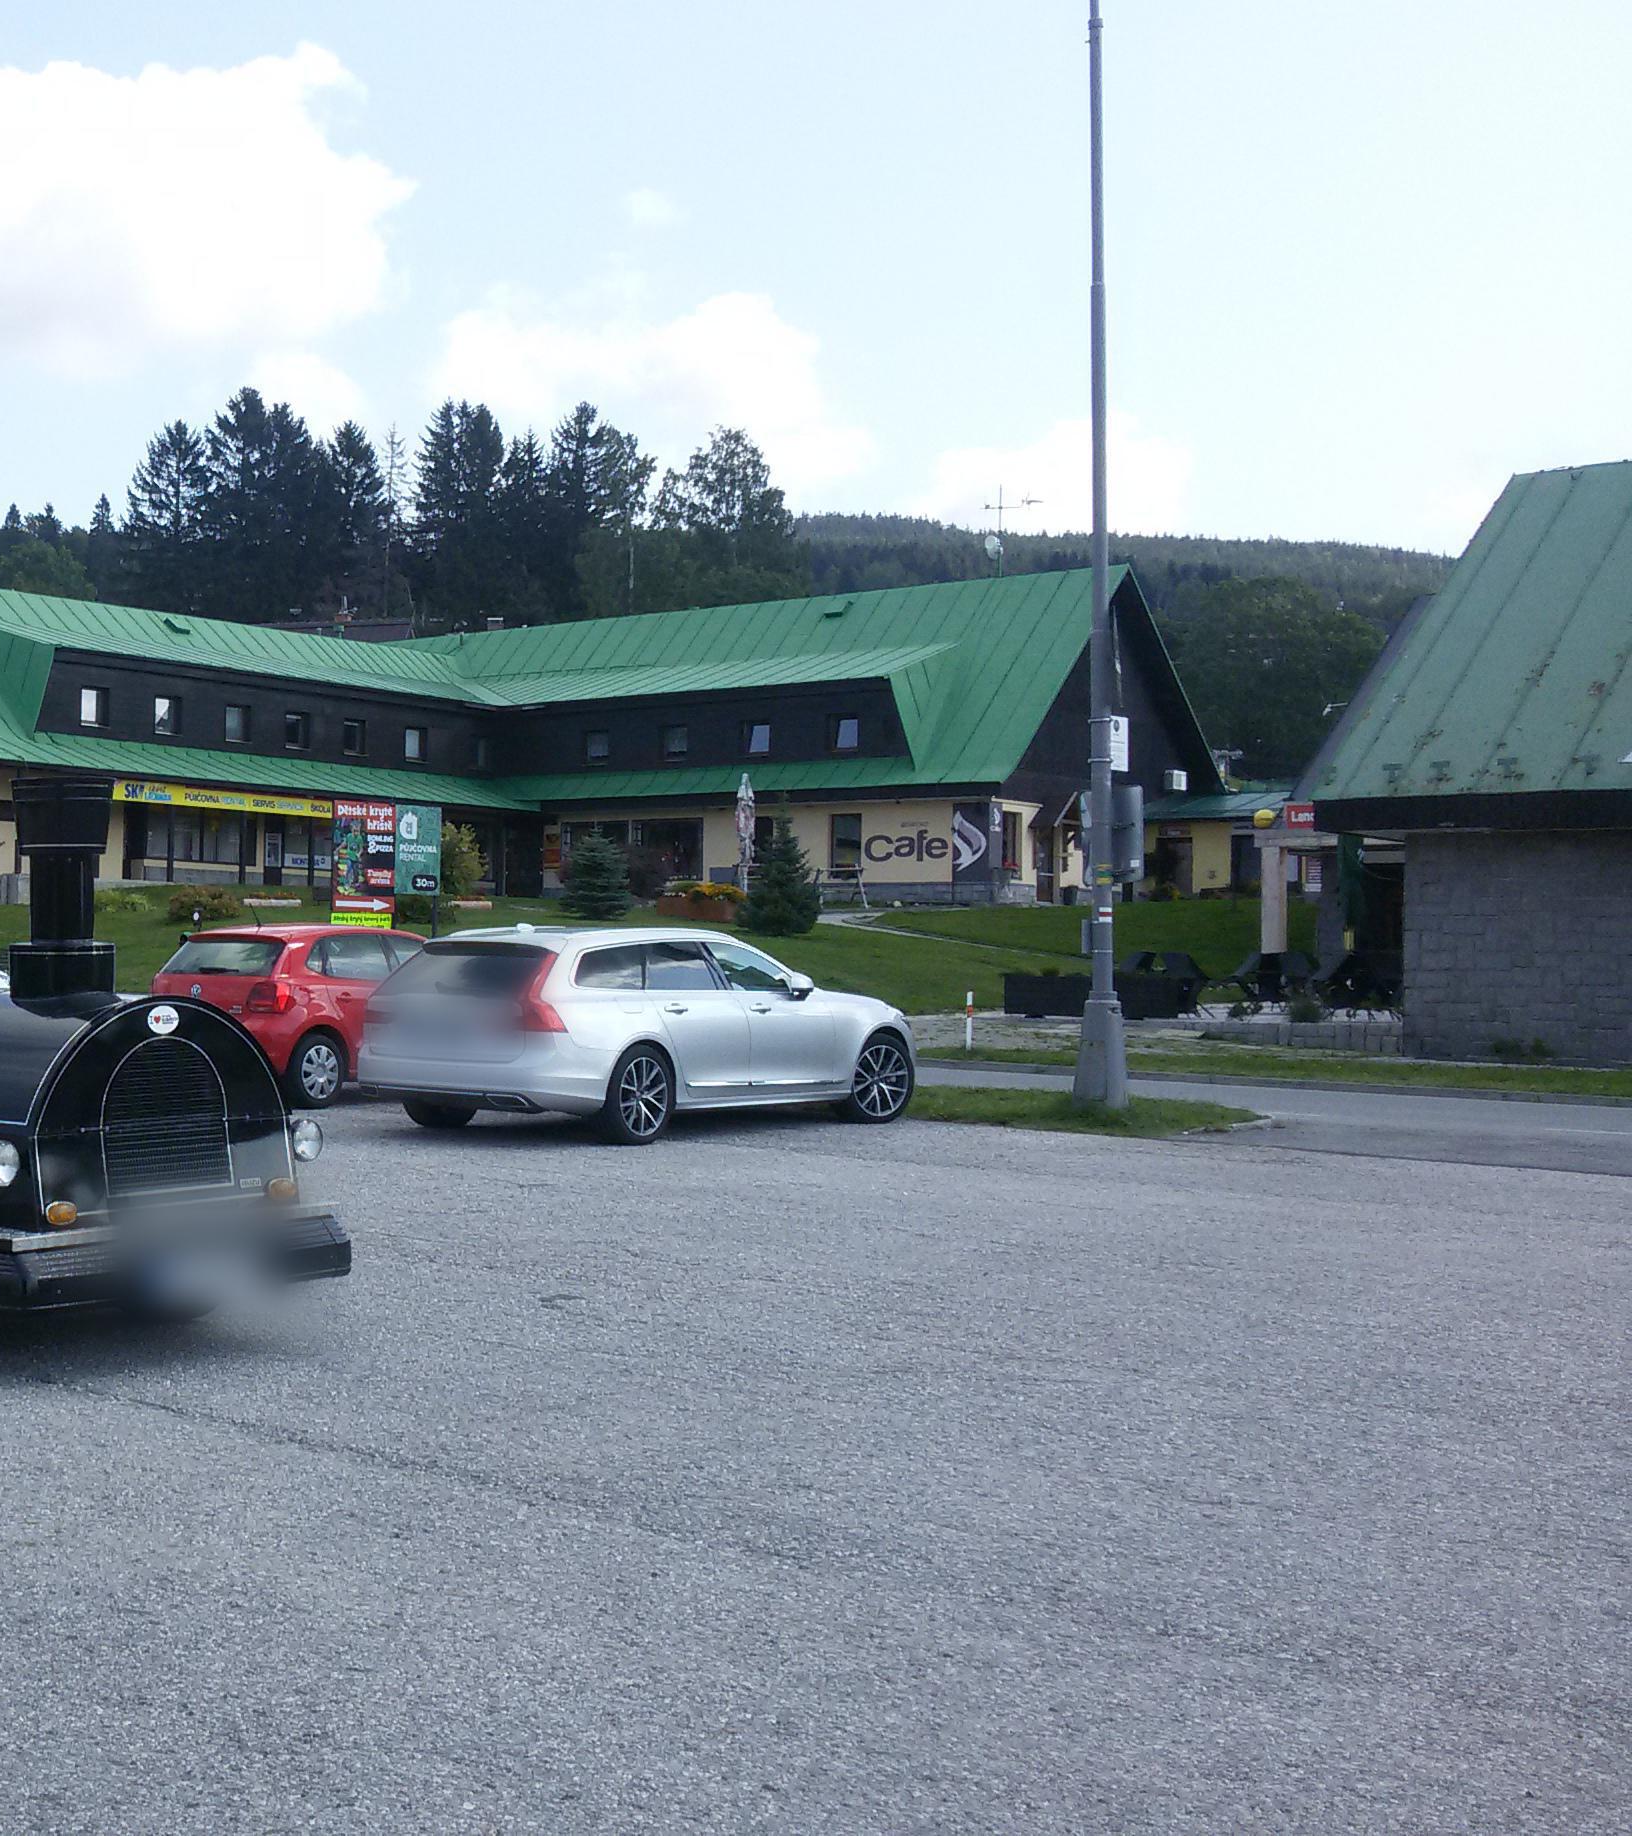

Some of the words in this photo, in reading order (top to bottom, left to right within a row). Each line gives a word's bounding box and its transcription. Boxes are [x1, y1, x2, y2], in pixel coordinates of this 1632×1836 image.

[337, 804, 367, 816] Dětské
[369, 805, 393, 822] kryté
[367, 818, 393, 830] hřiště
[399, 843, 437, 854] PŮJČOVNA
[399, 853, 426, 862] RENTAL
[415, 878, 435, 888] 30m
